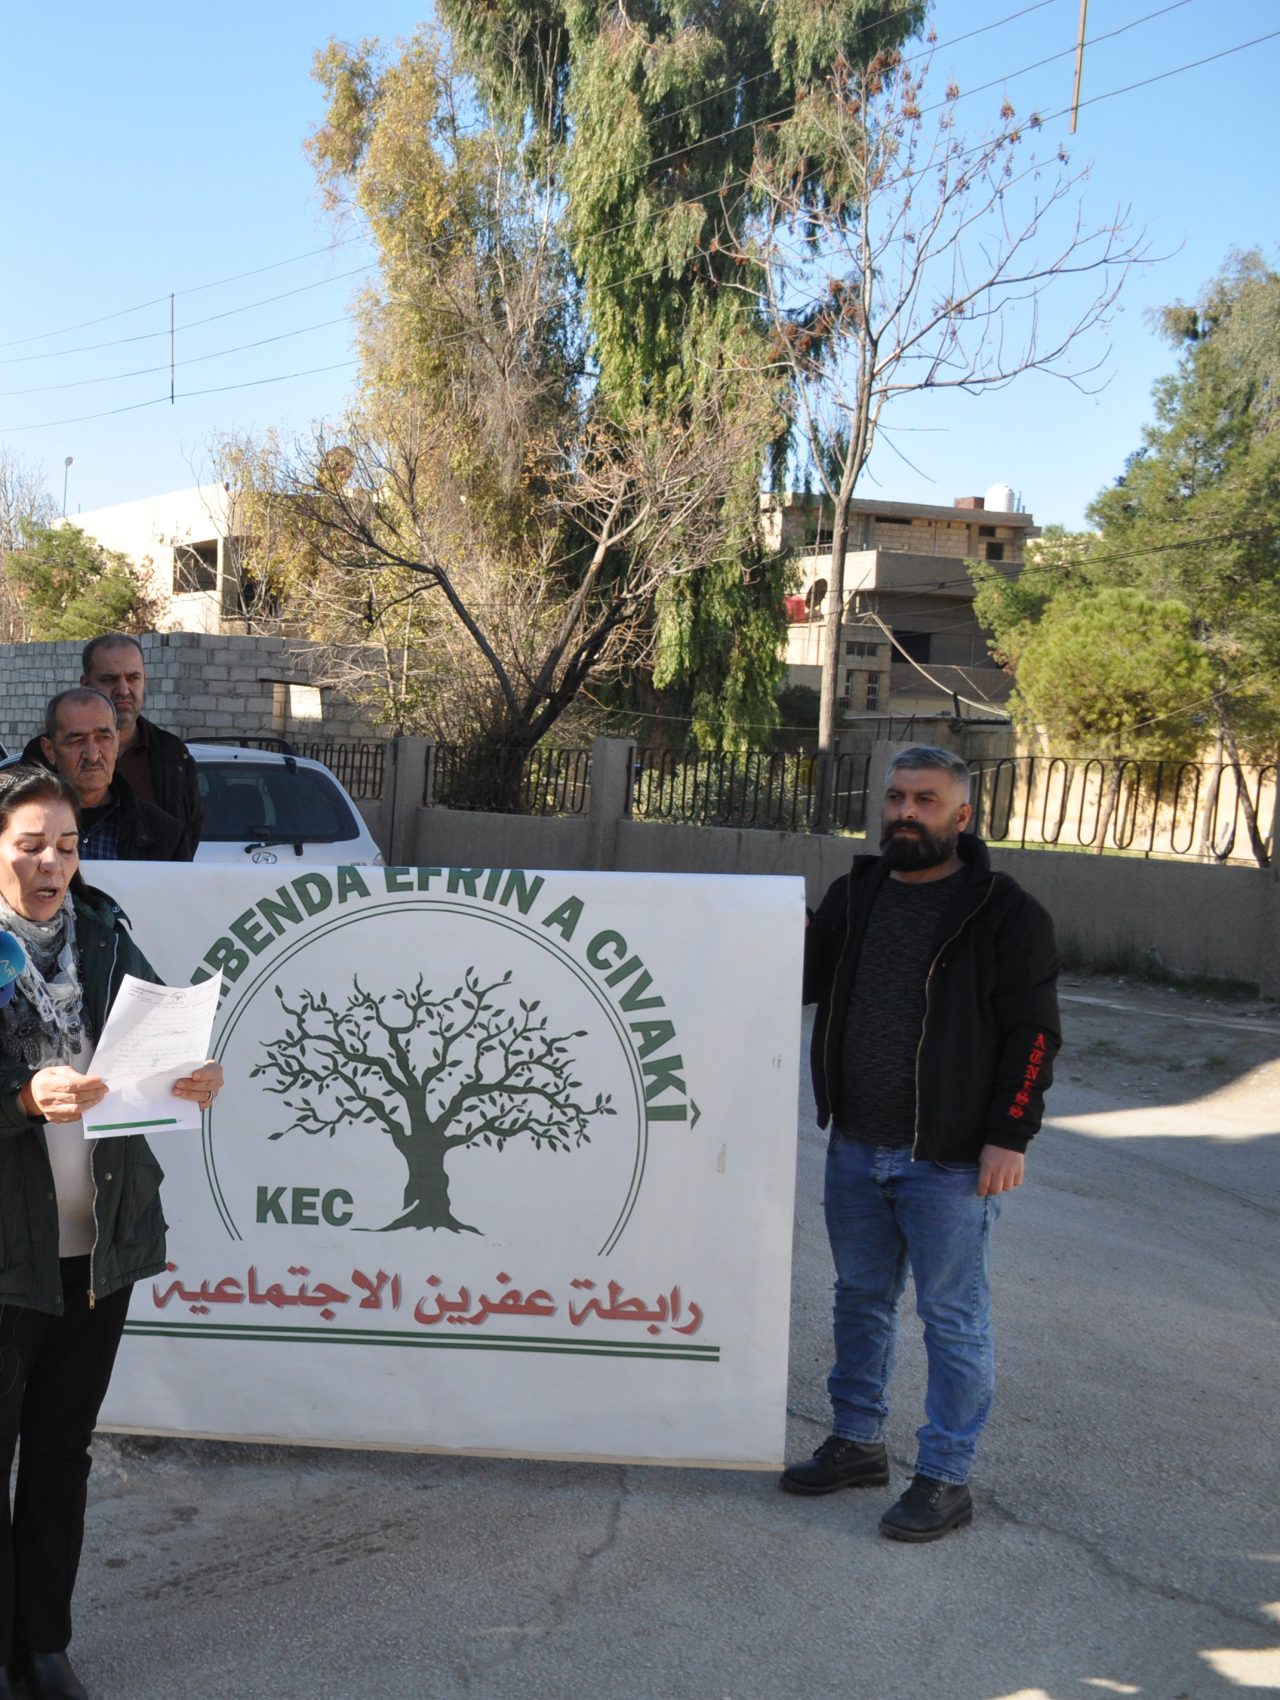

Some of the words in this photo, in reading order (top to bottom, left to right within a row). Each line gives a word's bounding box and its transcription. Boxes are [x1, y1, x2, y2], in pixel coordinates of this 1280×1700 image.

[541, 895, 585, 943] A
[586, 929, 701, 1131] CIVAKÎ
[255, 1186, 354, 1226] KEC
[152, 1262, 401, 1321] الاجتماعية
[413, 1270, 558, 1325] عفرين
[569, 1277, 704, 1335] رابطة
